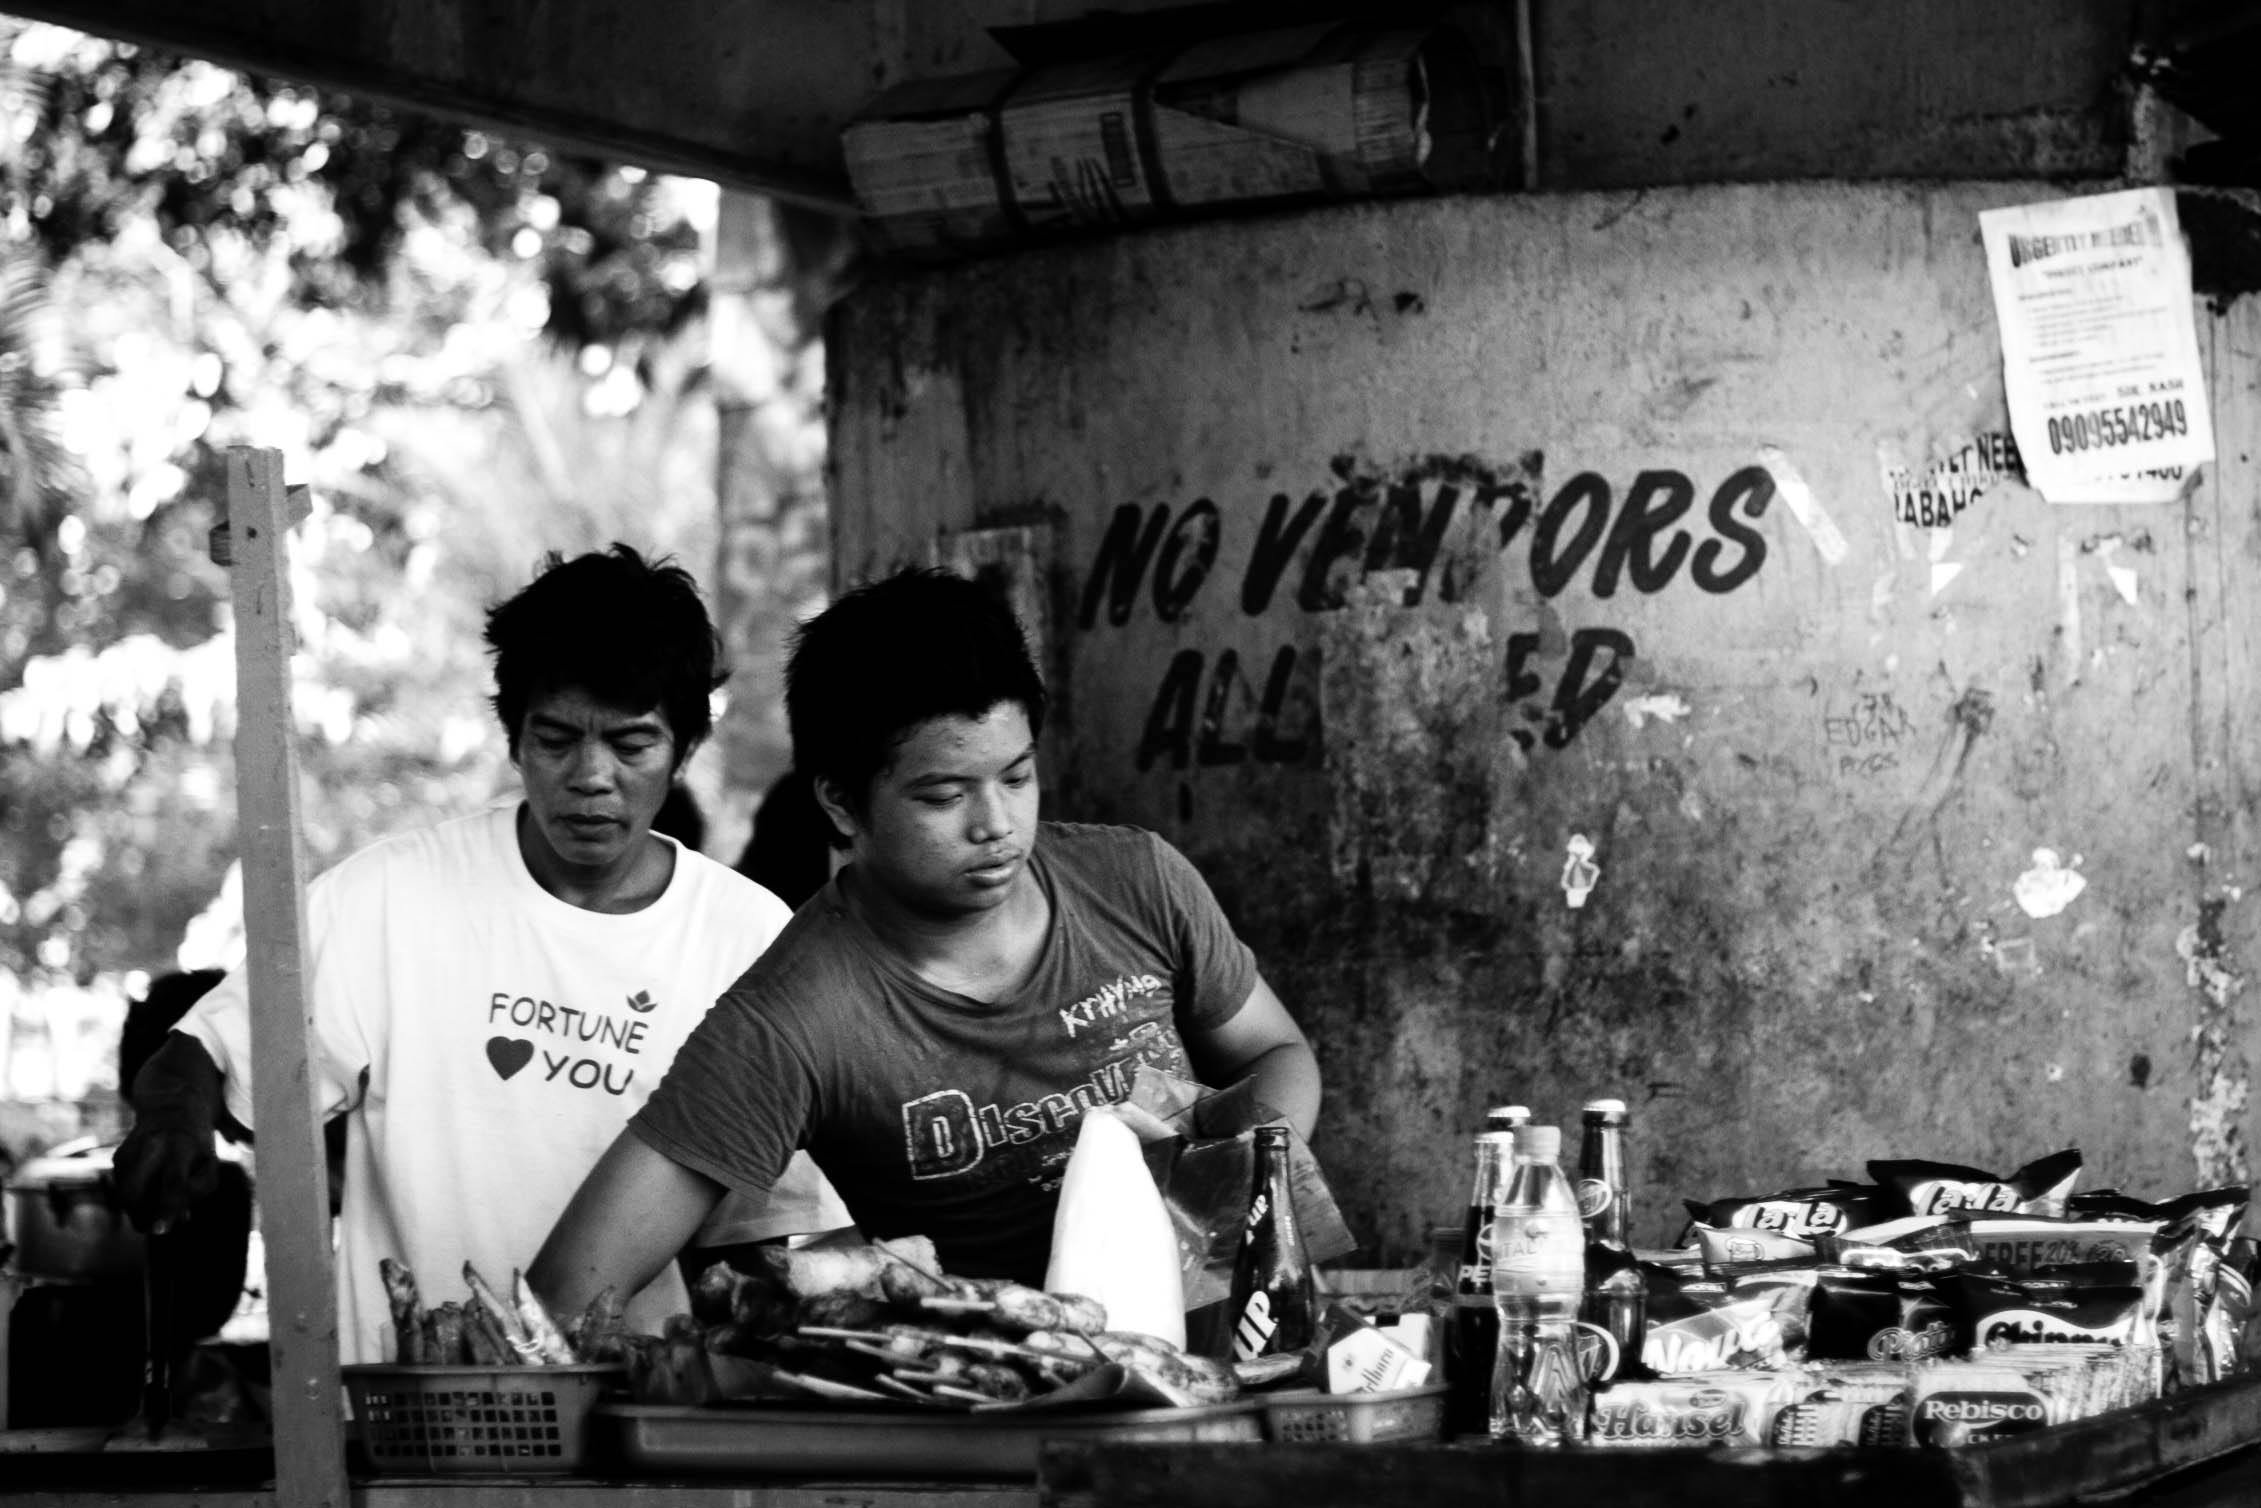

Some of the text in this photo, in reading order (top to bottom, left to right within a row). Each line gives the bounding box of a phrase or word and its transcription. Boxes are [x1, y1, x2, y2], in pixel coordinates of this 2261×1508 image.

[2047, 398, 2188, 455] 09095542949
[1078, 497, 1221, 631] NO
[1134, 626, 1636, 773] ALLED
[489, 991, 649, 1056] FORTUNE
[541, 1048, 636, 1097] YOU
[1600, 1401, 1748, 1441] Hansel
[1923, 1399, 2044, 1421] Rebisco
